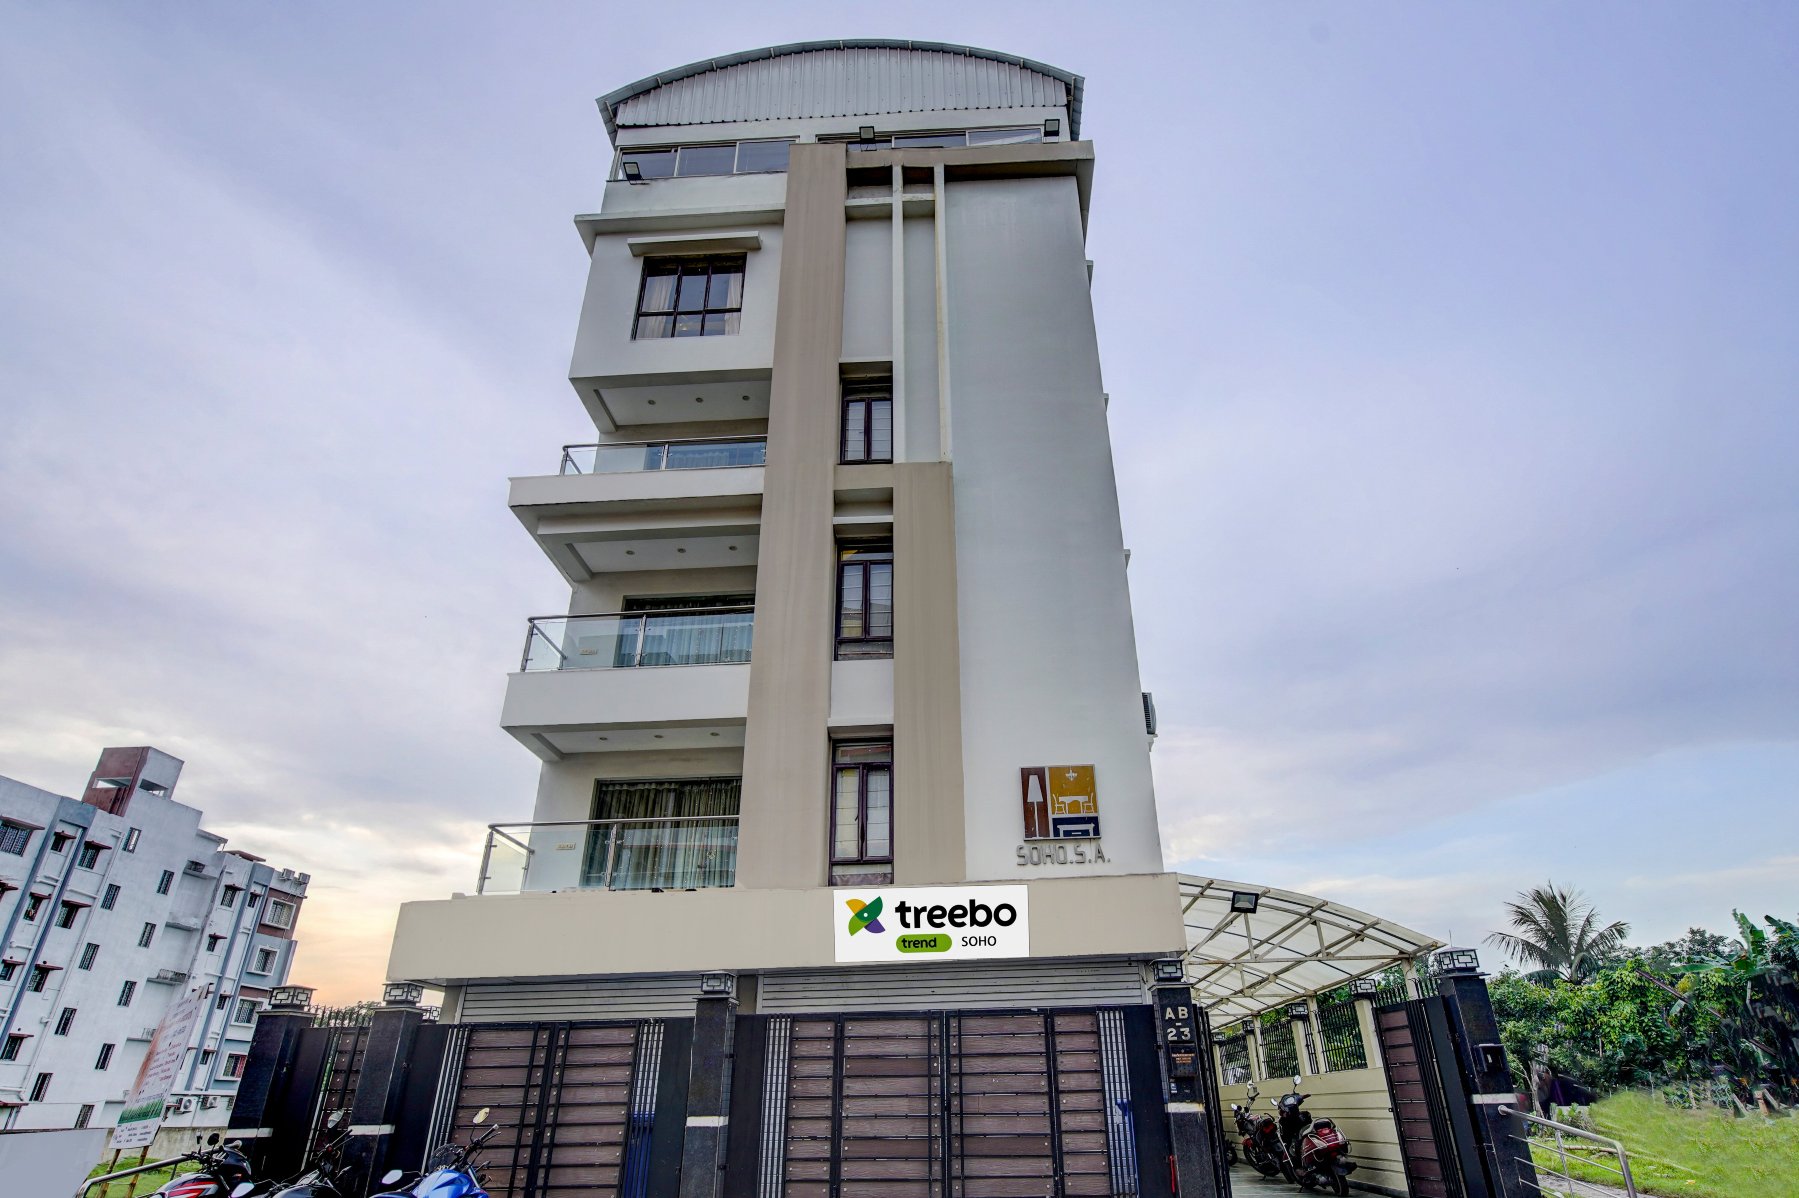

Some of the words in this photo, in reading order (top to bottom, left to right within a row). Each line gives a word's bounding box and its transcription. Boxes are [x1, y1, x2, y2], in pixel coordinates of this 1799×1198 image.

[1016, 843, 1111, 866] SOHO.S.A.
[895, 898, 1017, 929] treebo
[901, 937, 937, 949] trend
[961, 935, 997, 947] SOHO
[1165, 1006, 1189, 1020] AB
[1166, 1027, 1191, 1041] 23
